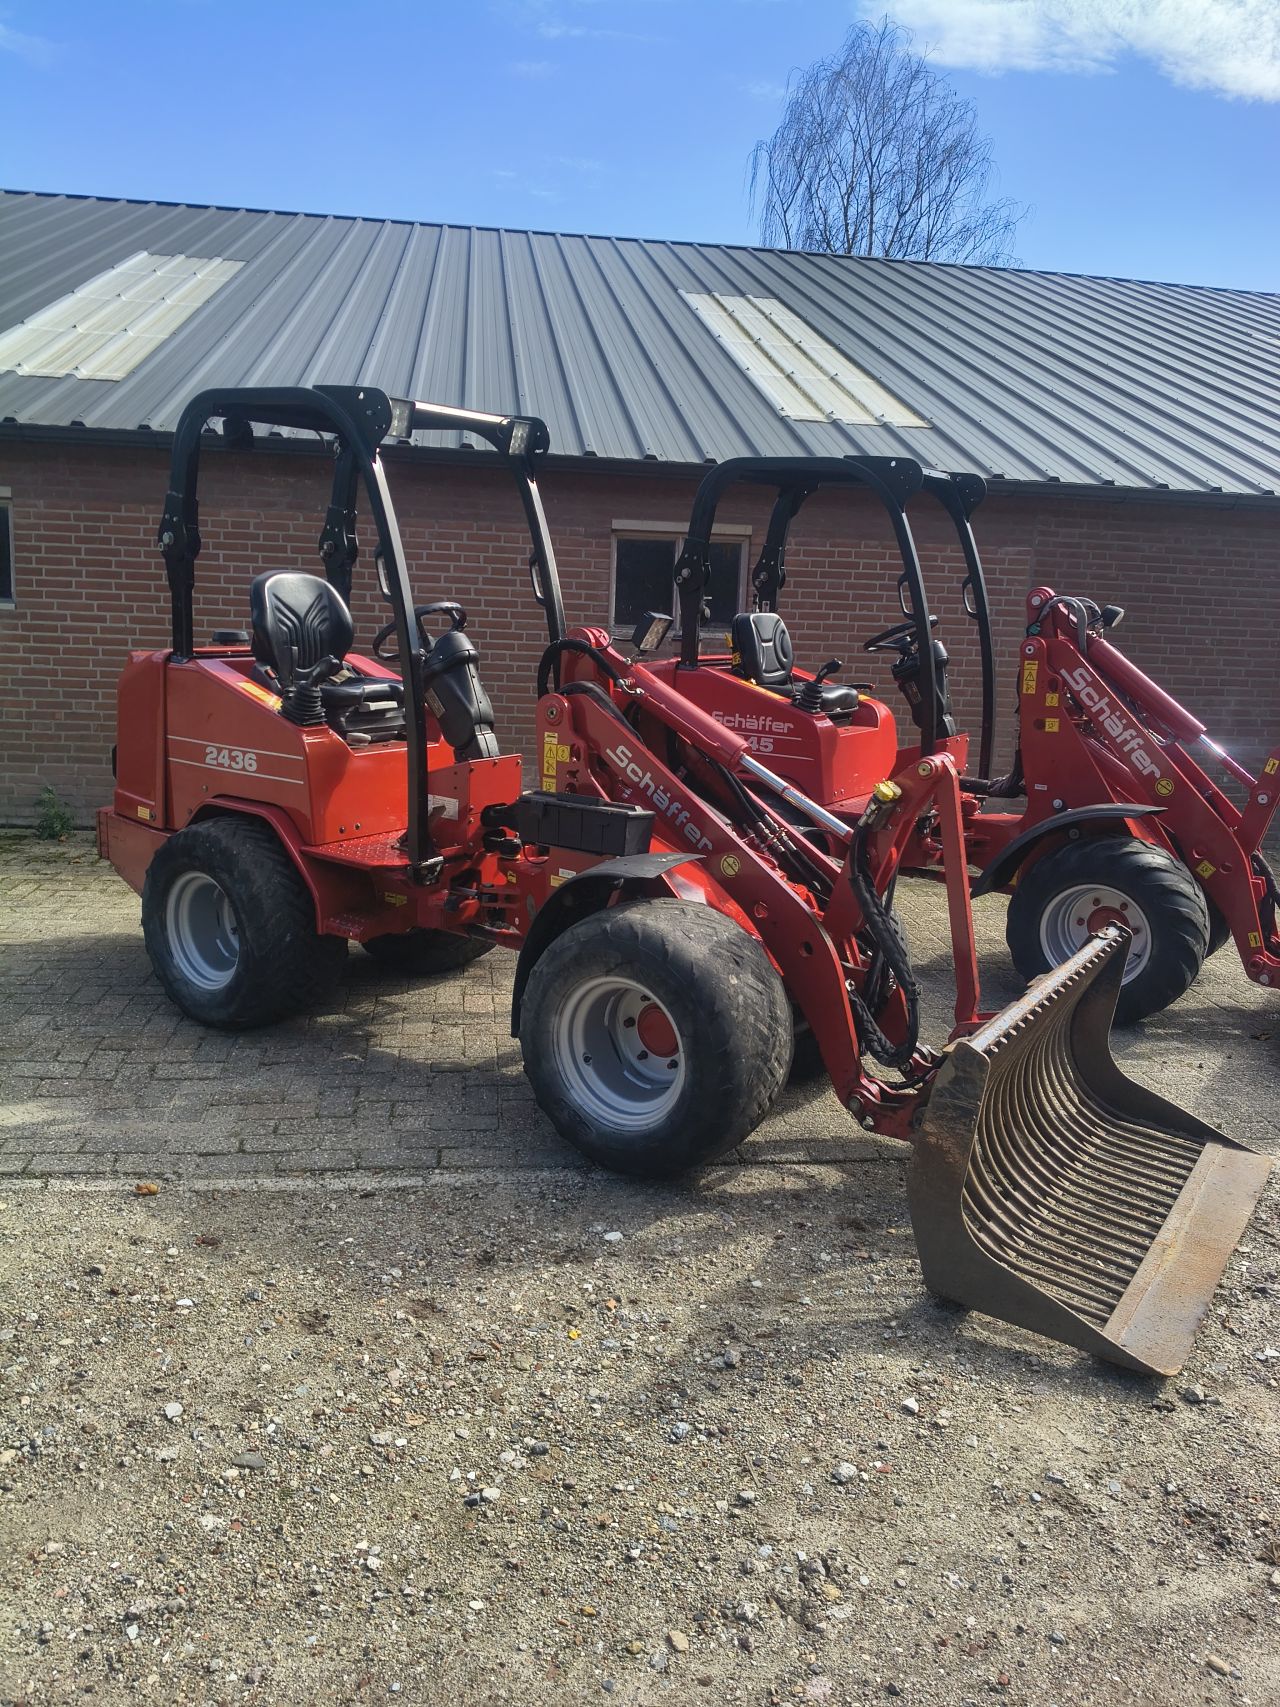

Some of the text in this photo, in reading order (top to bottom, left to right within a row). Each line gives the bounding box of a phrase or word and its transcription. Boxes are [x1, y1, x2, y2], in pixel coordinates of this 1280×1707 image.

[205, 746, 258, 772] 2436
[1060, 667, 1160, 779] Schäffer
[605, 745, 712, 850] Schäffer
